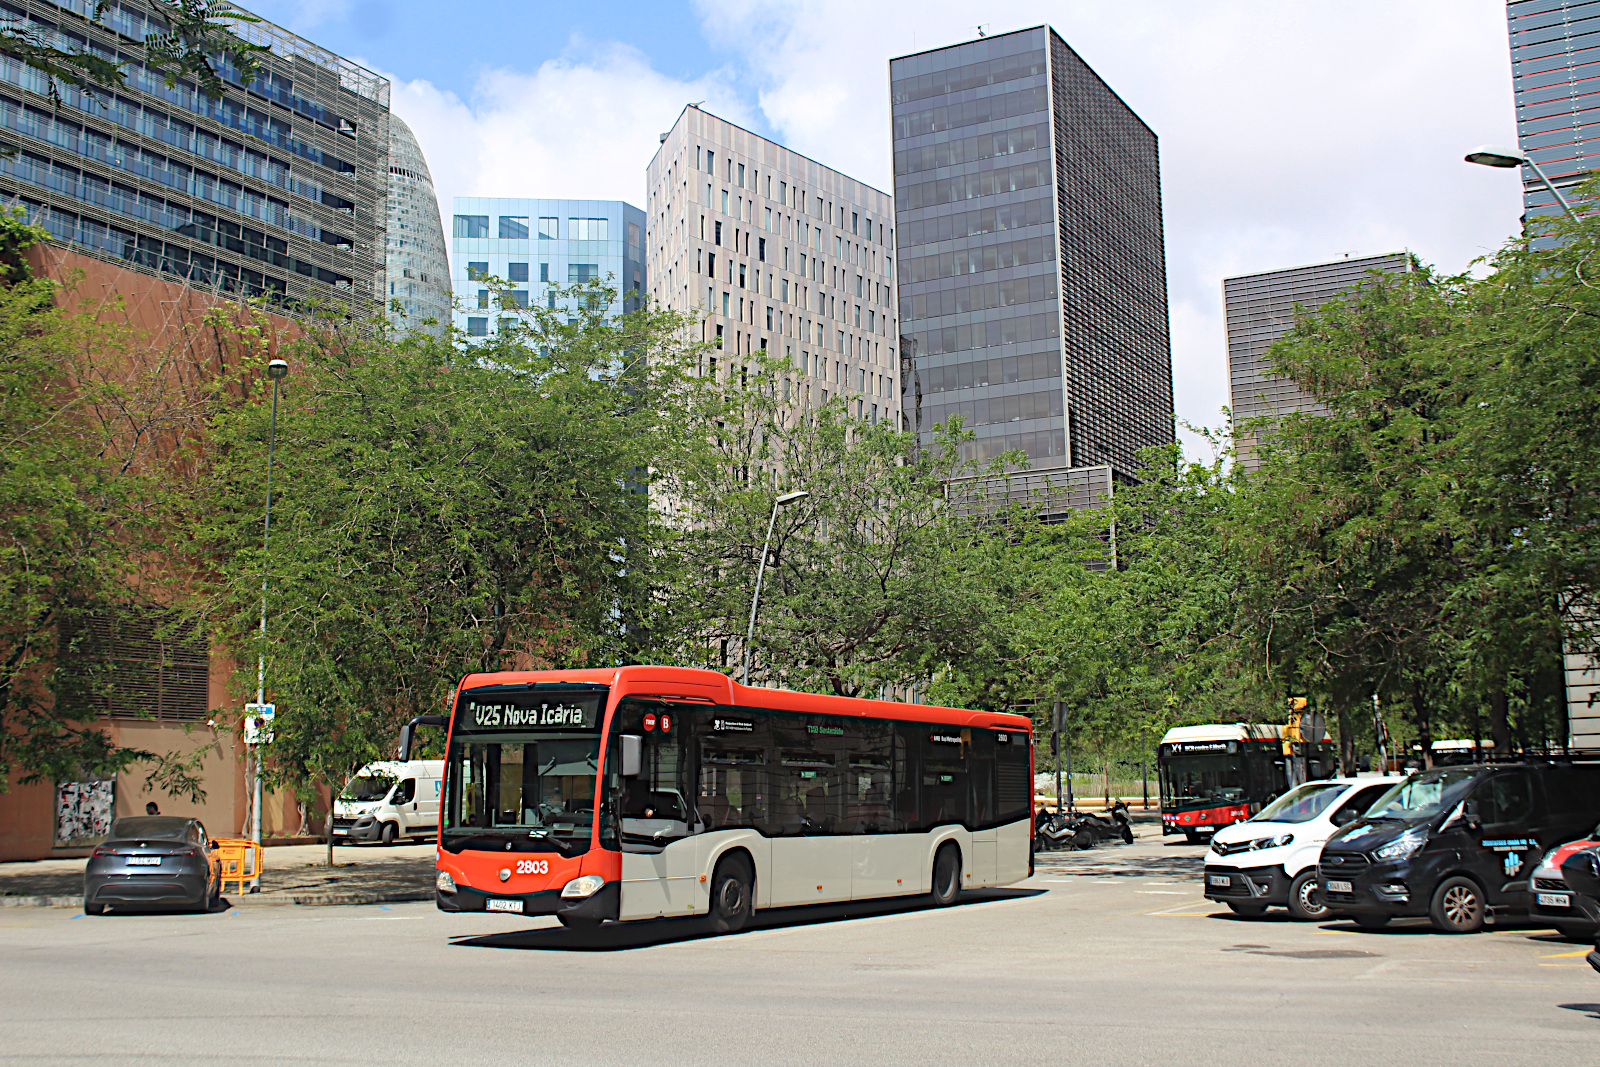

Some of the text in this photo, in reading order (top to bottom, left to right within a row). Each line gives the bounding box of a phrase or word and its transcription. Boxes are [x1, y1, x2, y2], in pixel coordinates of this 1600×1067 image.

[504, 704, 537, 725] Nova
[540, 703, 583, 724] Icària
[663, 717, 670, 729] B
[516, 859, 549, 875] 2803
[492, 900, 521, 911] 1402 KTJ
